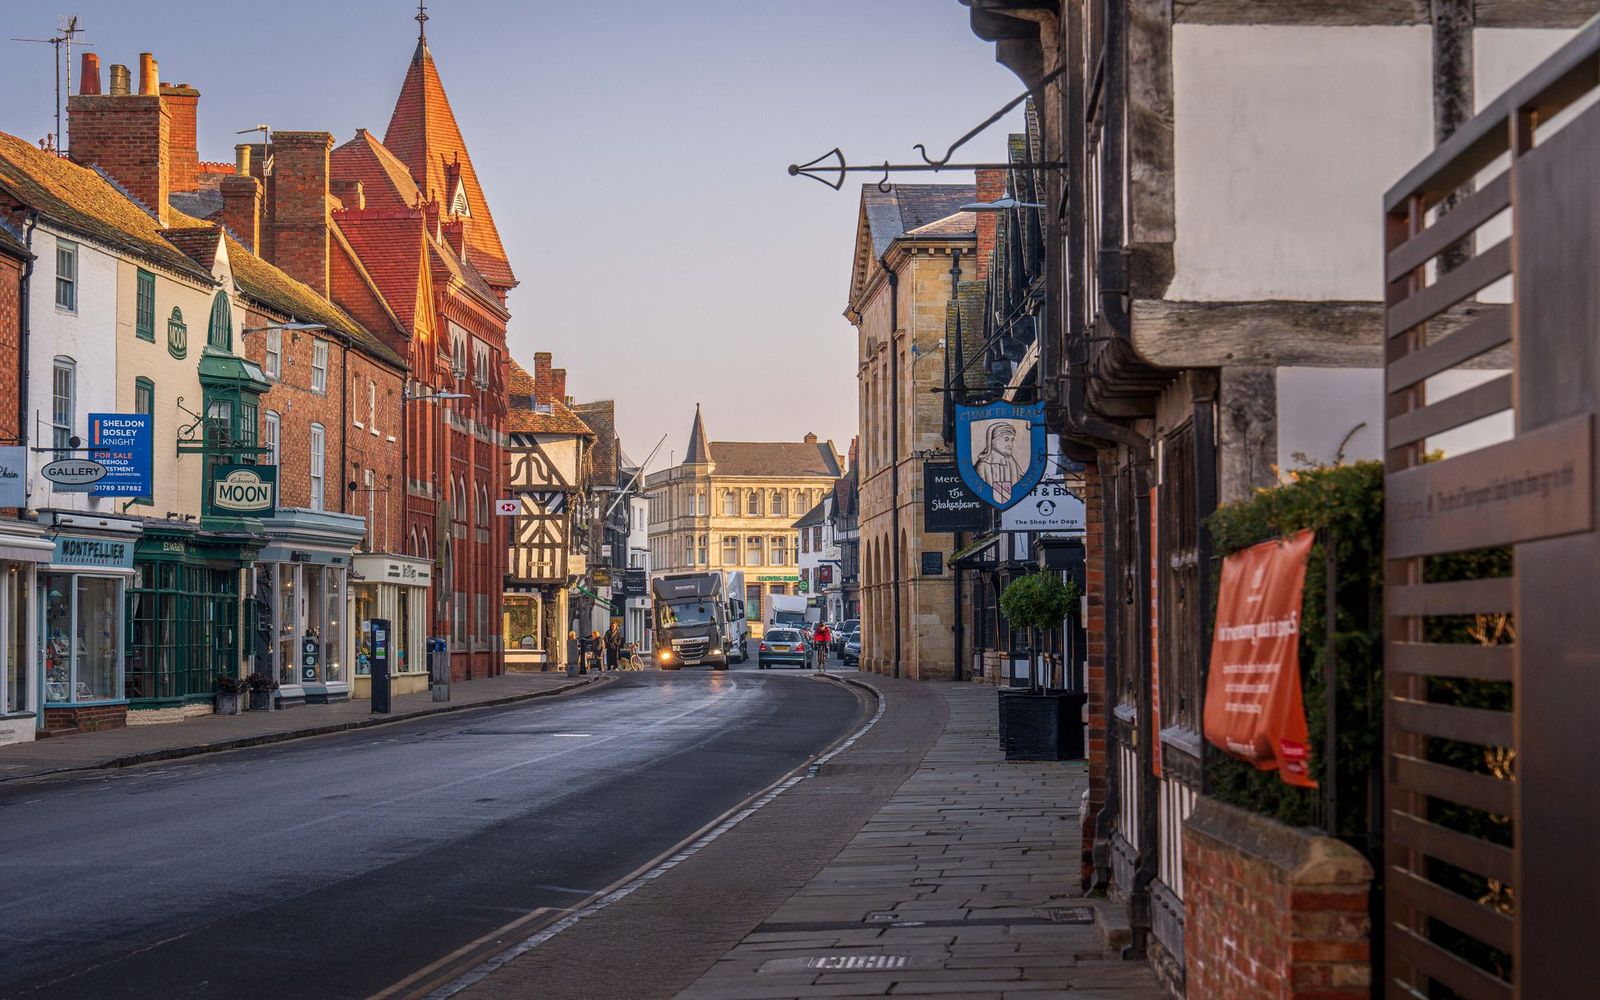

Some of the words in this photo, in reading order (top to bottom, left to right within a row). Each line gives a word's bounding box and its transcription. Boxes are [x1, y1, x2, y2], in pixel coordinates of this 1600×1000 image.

[103, 420, 145, 428] SHELDON
[103, 429, 138, 437] BOSLEY
[102, 438, 135, 446] KNIGHT
[48, 467, 100, 476] GALLERY
[219, 485, 268, 502] MOON
[1041, 487, 1050, 496] &
[931, 500, 981, 511] Shakespeare
[62, 540, 125, 559] MONTPELLIER
